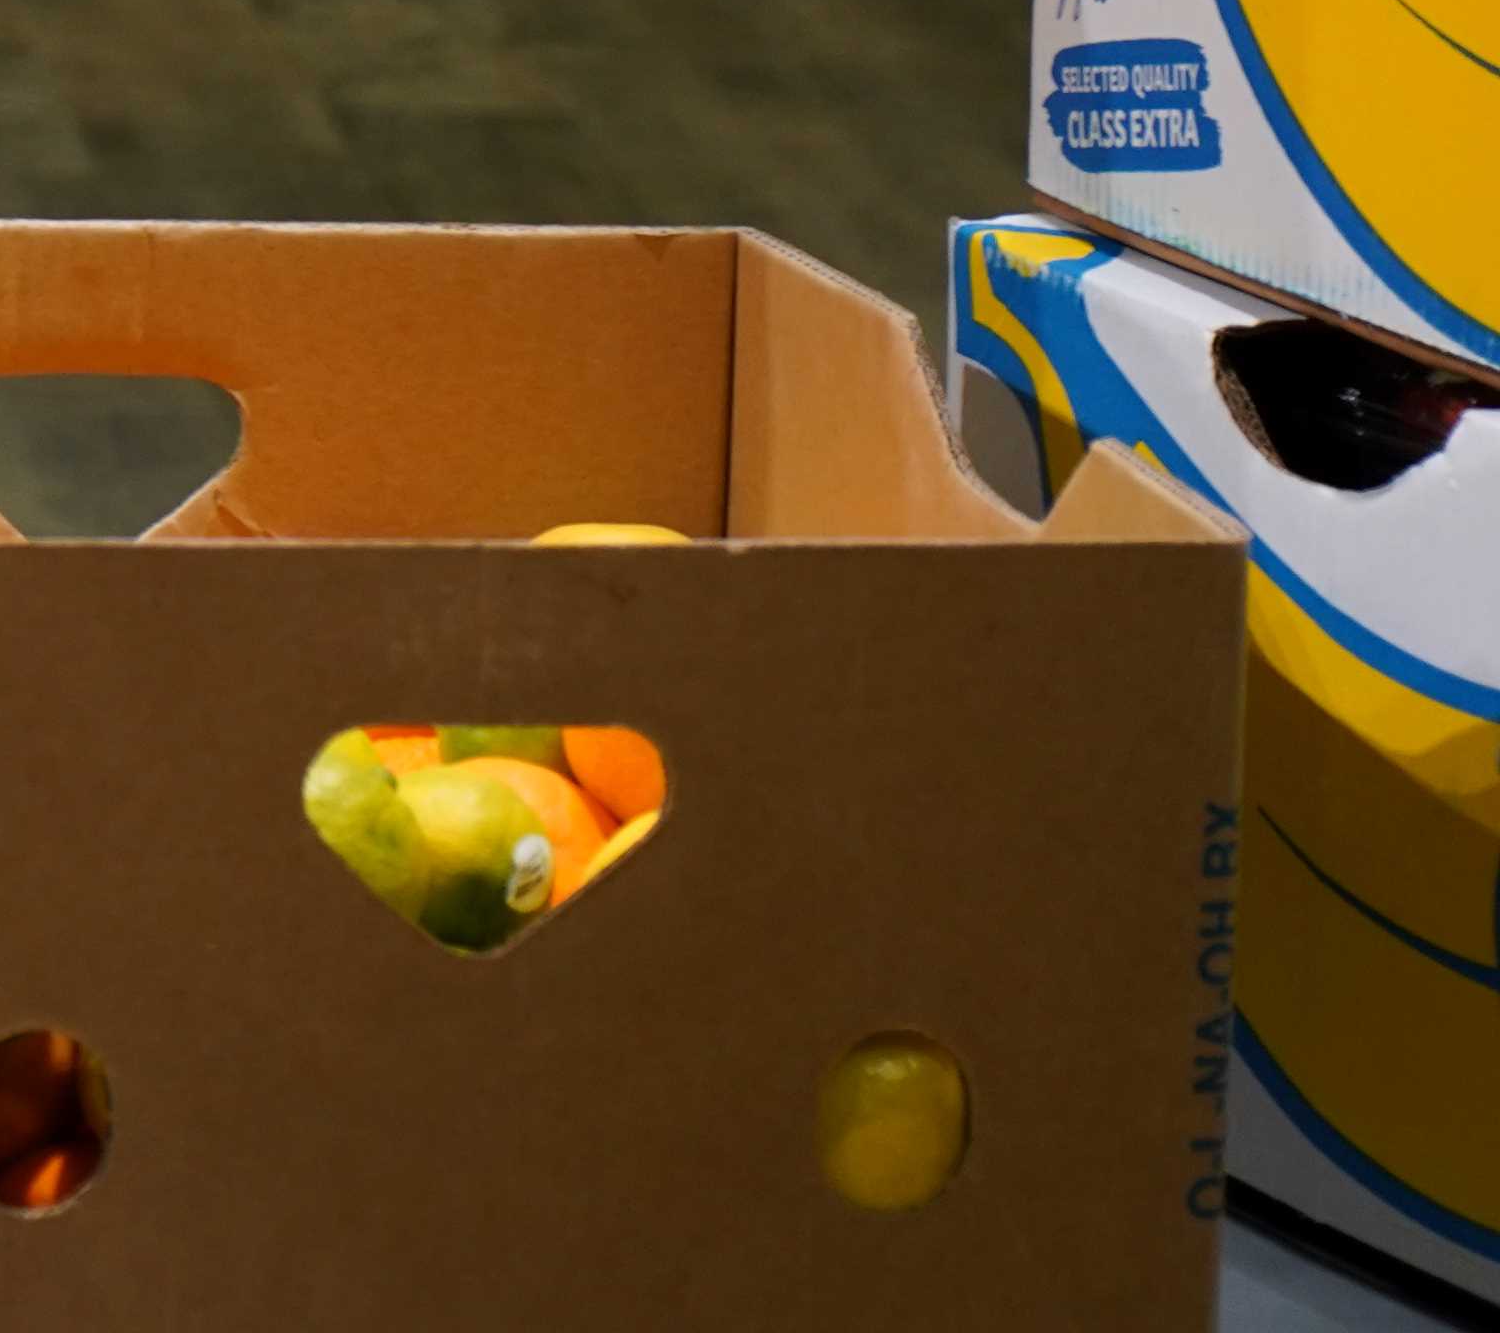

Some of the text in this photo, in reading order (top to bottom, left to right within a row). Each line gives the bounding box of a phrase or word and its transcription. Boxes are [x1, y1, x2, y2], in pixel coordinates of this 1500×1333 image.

[1061, 63, 1200, 99] SELECTED QUALITY
[1067, 108, 1201, 149] CLASS EXTRA
